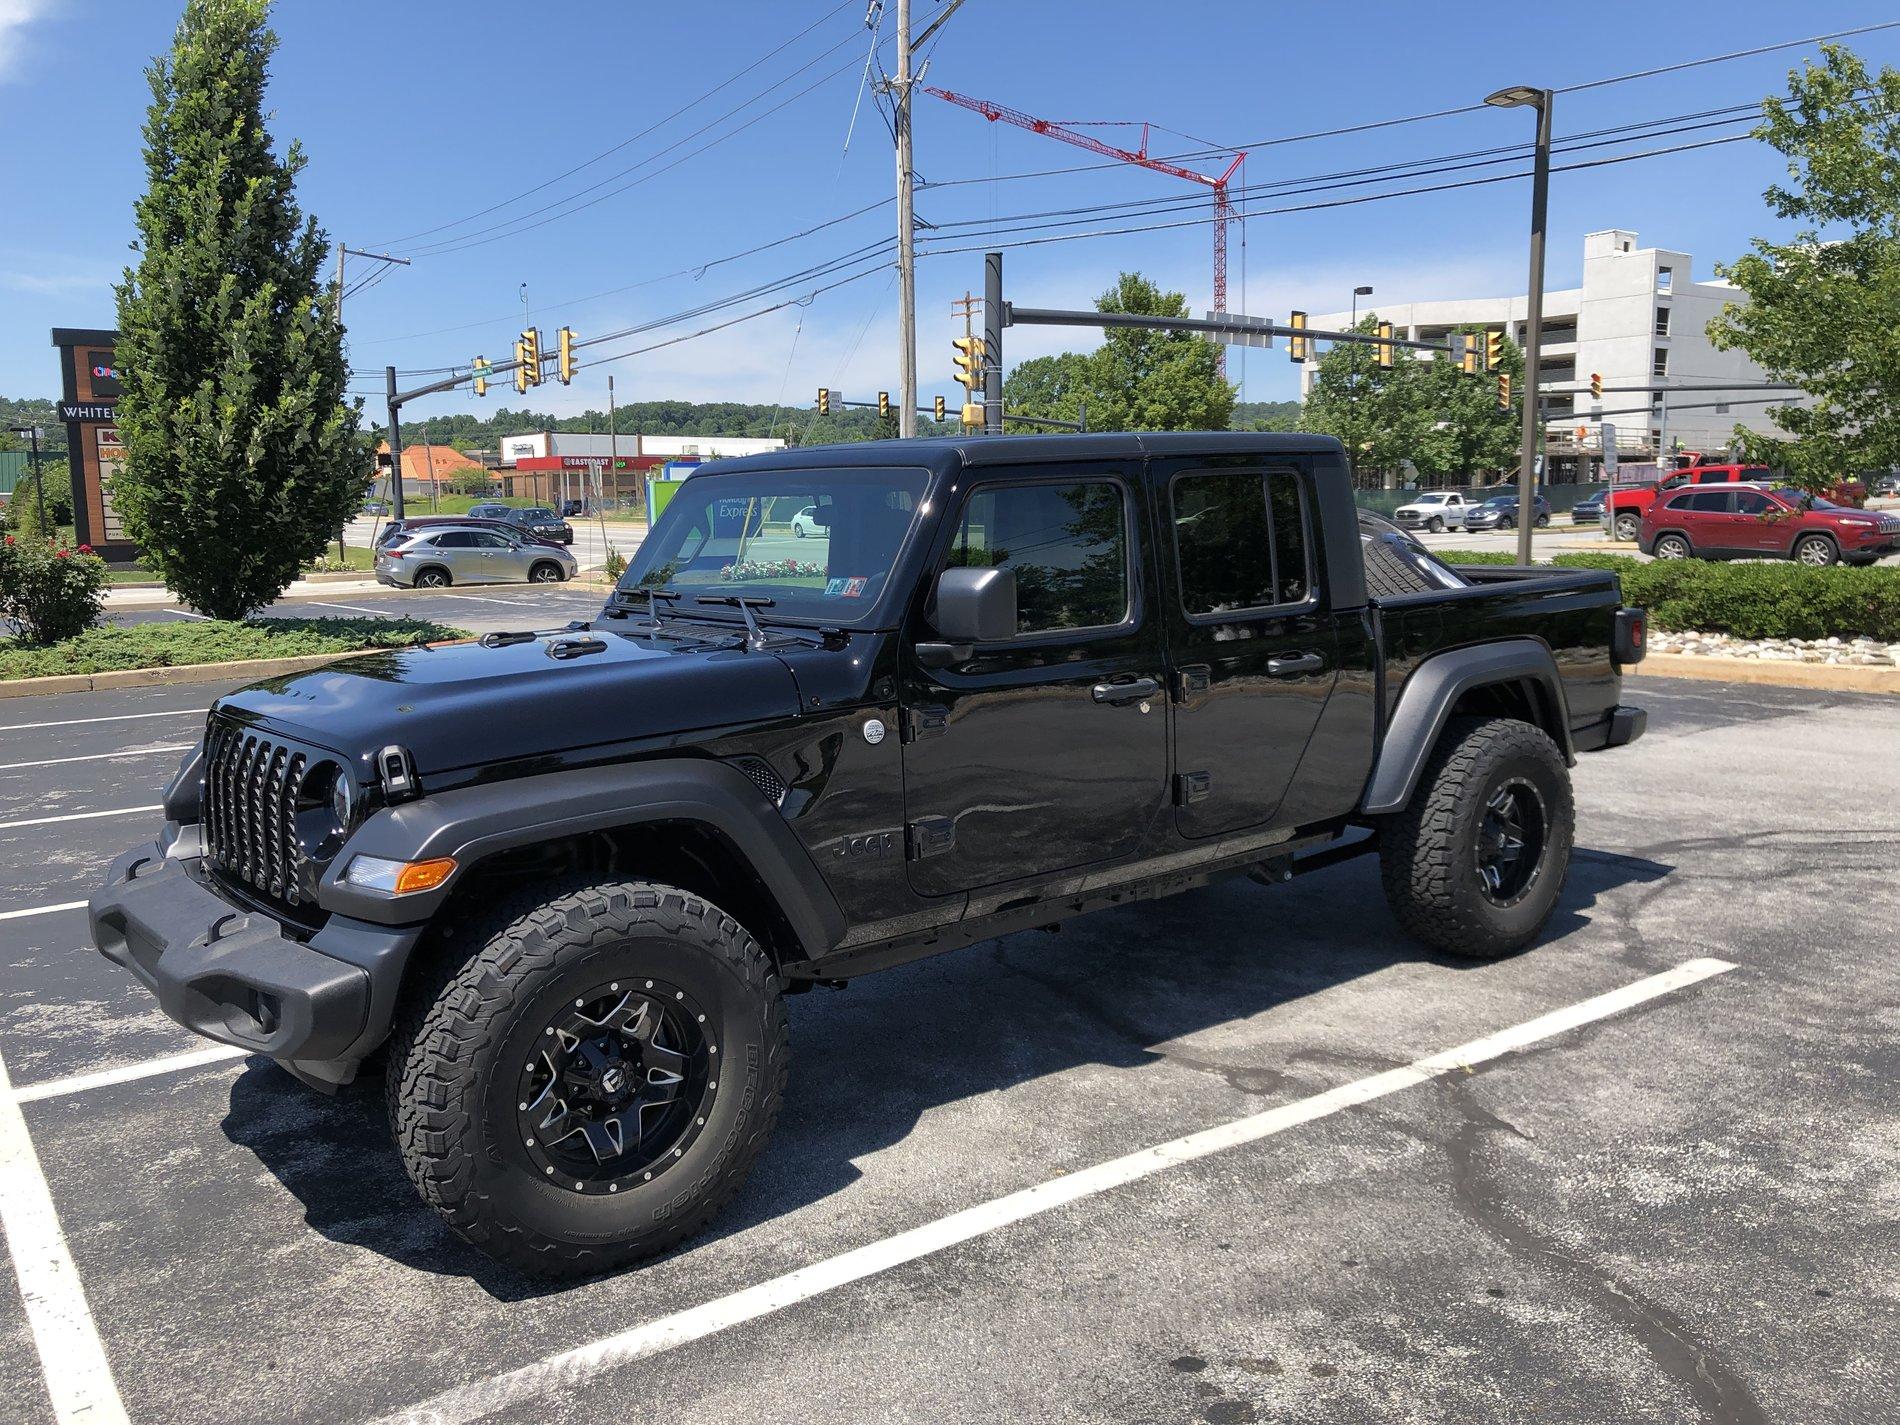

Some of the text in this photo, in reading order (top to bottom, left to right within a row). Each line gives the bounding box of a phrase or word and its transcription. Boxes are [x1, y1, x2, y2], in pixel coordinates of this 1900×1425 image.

[63, 406, 123, 418] WHITEL
[719, 505, 758, 519] Expres
[832, 833, 892, 858] Jeep
